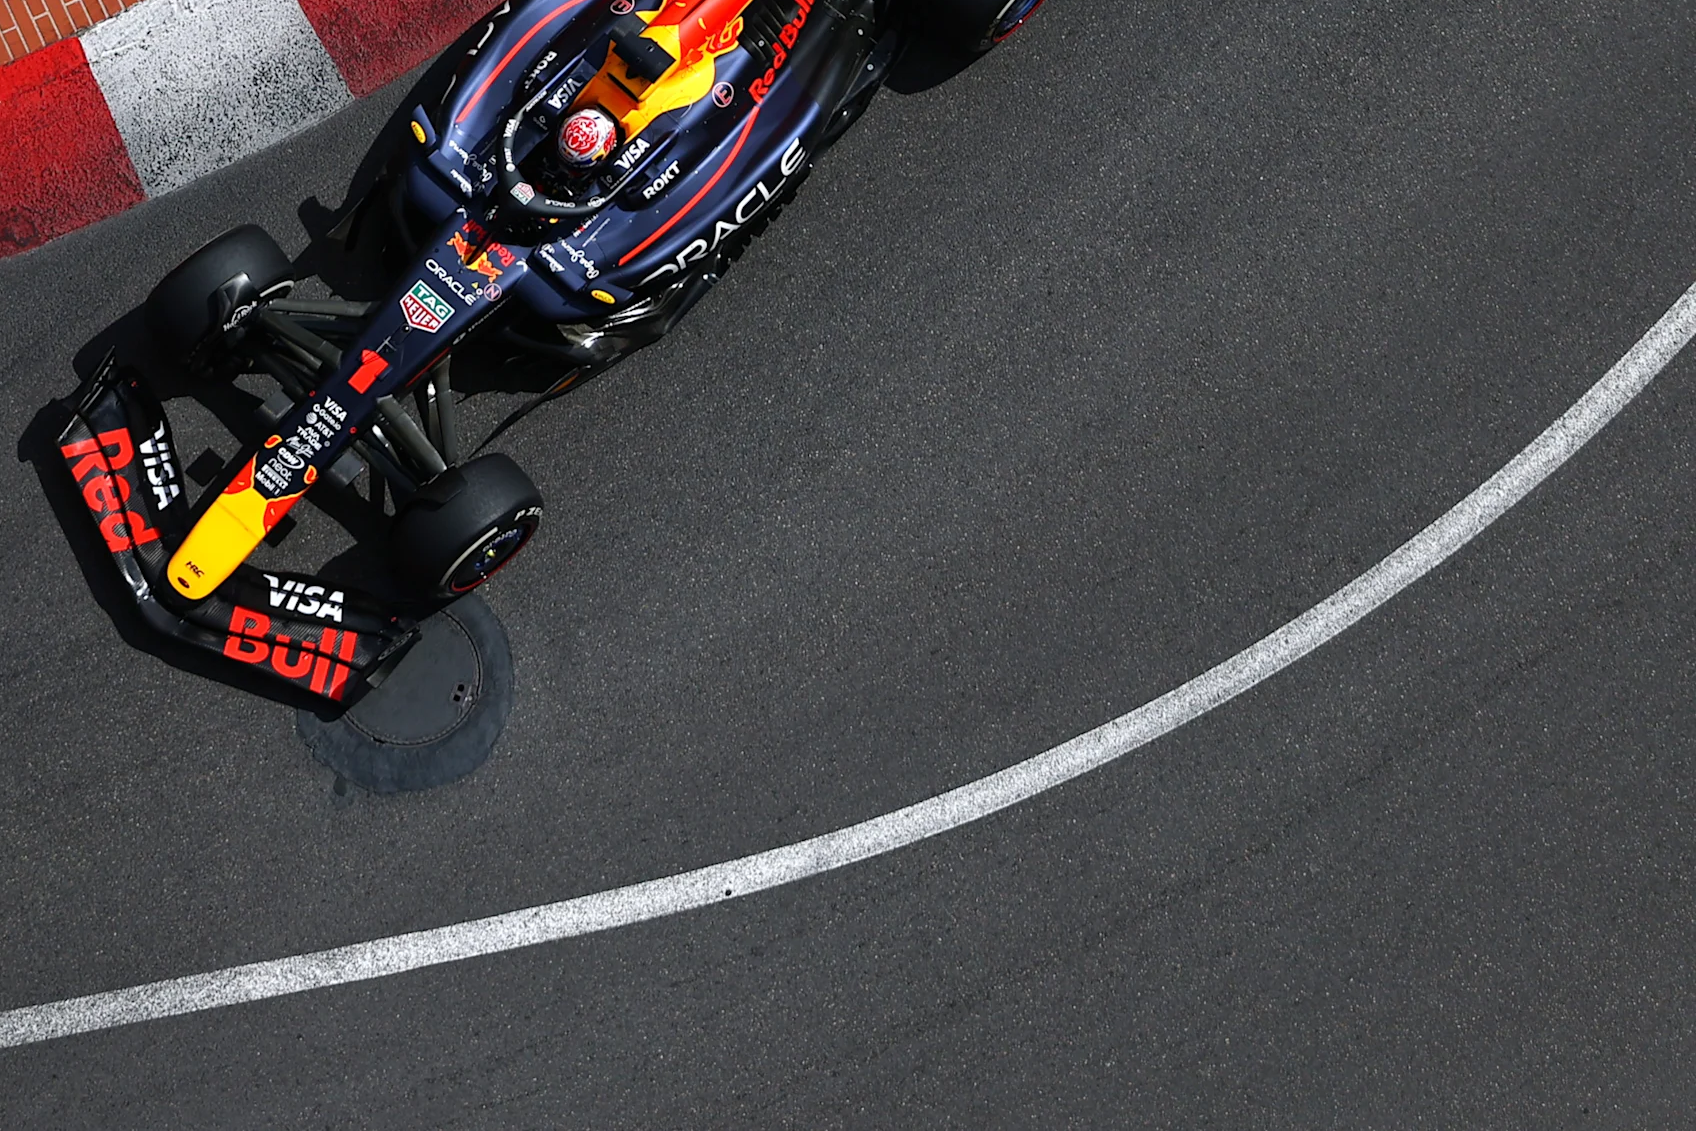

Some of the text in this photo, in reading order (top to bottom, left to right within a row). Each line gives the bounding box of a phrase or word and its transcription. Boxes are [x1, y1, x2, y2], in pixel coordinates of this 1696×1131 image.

[748, 41, 788, 106] Red
[547, 78, 584, 109] VISA
[503, 119, 516, 138] VISA
[613, 137, 651, 170] VISA
[642, 160, 680, 200] ROKT
[544, 198, 576, 209] ORACLE
[487, 242, 516, 267] Red
[425, 258, 477, 307] ORACLE
[403, 296, 440, 329] HEUER
[416, 286, 450, 318] TAG
[348, 349, 389, 394] 1
[319, 409, 342, 431] Gate.io
[323, 395, 348, 422] VISA
[296, 426, 323, 451] TRADE
[305, 426, 321, 442] AVA
[314, 422, 335, 439] AT&T
[139, 419, 180, 511] VISA
[278, 447, 300, 466] CDW
[60, 427, 162, 553] Red
[255, 471, 275, 491] Mobil
[261, 464, 289, 490] PIRELLI
[514, 509, 526, 521] P
[185, 561, 206, 579] HRC
[262, 573, 345, 623] VISA
[223, 605, 358, 702] Bull
